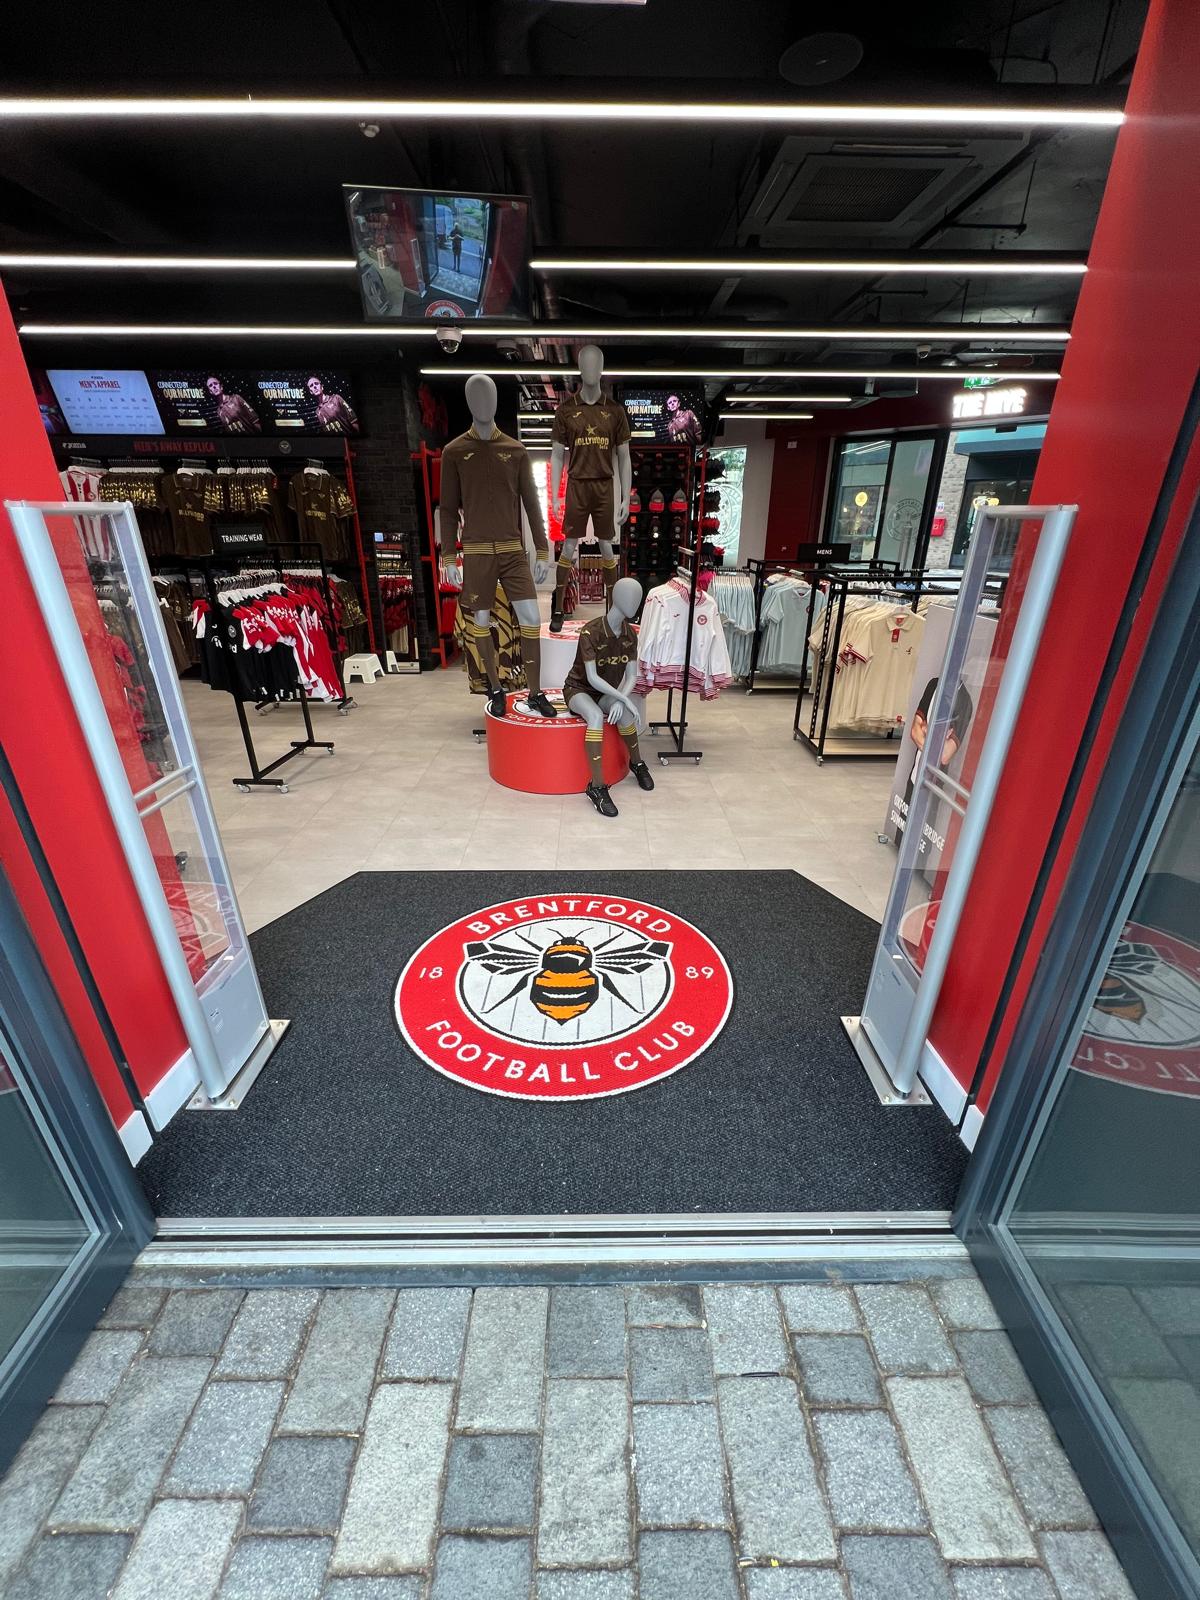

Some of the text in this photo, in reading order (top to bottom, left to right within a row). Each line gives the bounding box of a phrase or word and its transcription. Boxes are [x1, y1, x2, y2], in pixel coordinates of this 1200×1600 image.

[177, 388, 205, 399] NATURE
[277, 388, 305, 399] NATURE
[639, 404, 662, 415] NATURE
[221, 533, 264, 543] TRAINING WEAR
[923, 822, 946, 852] BRIDGE
[467, 900, 673, 935] BRENTFORD
[419, 966, 714, 979] 18 89
[425, 1020, 696, 1083] FOOTBALL CLUB
